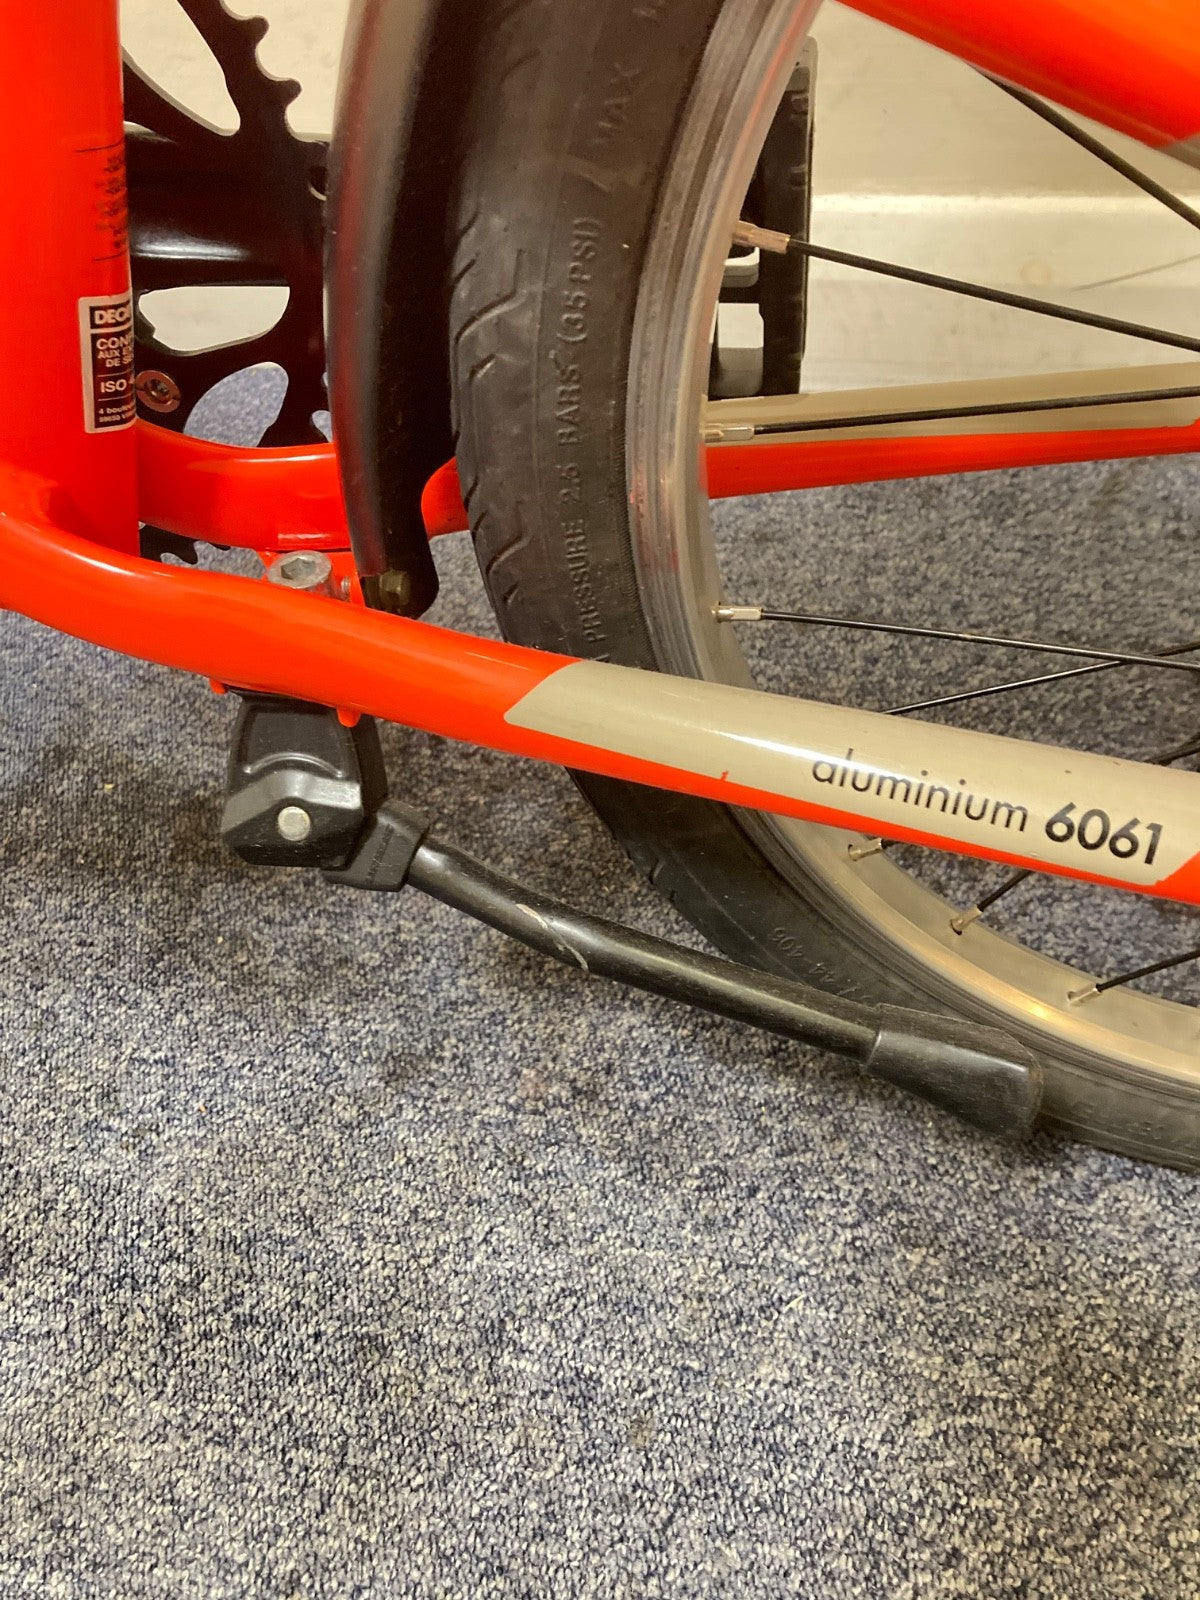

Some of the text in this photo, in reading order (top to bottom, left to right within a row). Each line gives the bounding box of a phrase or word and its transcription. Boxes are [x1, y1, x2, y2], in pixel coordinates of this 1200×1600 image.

[98, 350, 121, 359] AUX
[105, 358, 121, 368] DE
[100, 379, 127, 393] ISO
[554, 362, 583, 446] BARS
[560, 517, 608, 642] PRESSURE
[811, 747, 1164, 866] aluminium 6061
